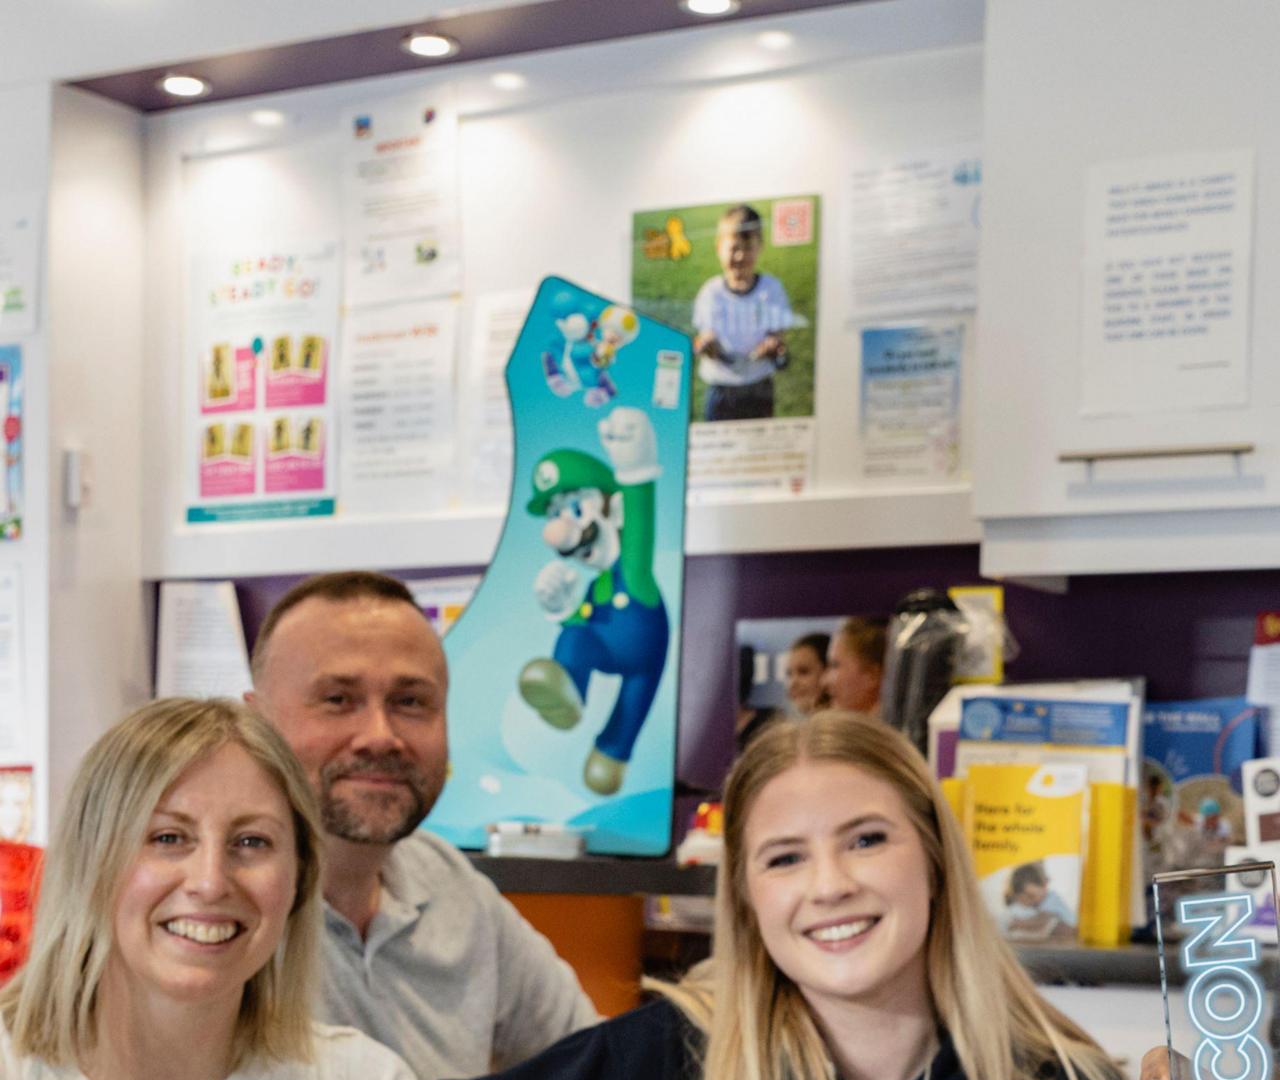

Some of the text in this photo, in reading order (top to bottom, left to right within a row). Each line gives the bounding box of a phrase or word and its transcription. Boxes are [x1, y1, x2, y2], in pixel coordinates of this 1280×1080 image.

[975, 802, 1037, 815] Here for
[975, 822, 1045, 834] the whole
